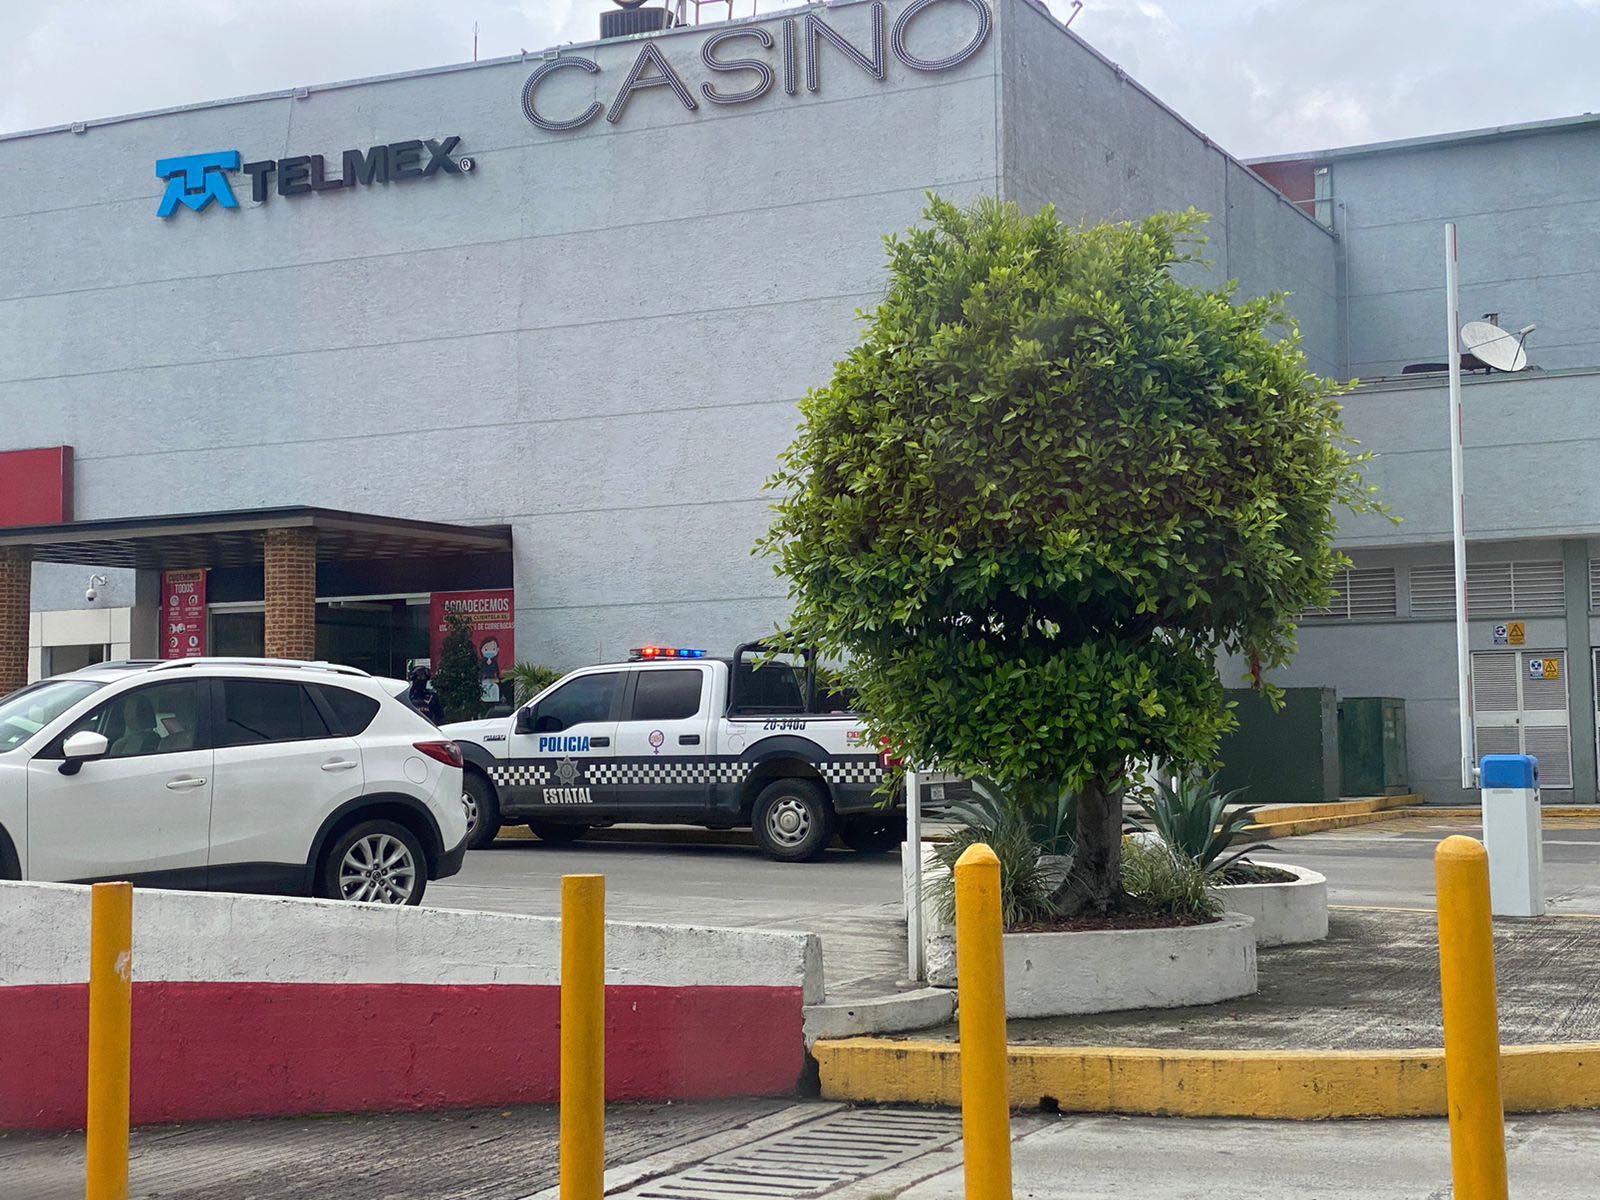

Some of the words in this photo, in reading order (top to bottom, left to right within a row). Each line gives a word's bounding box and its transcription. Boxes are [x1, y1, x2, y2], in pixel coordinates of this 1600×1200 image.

[520, 0, 993, 131] CASINO
[175, 583, 194, 594] TODOS
[539, 736, 590, 752] POLICIA
[543, 787, 593, 804] ESTATAL
